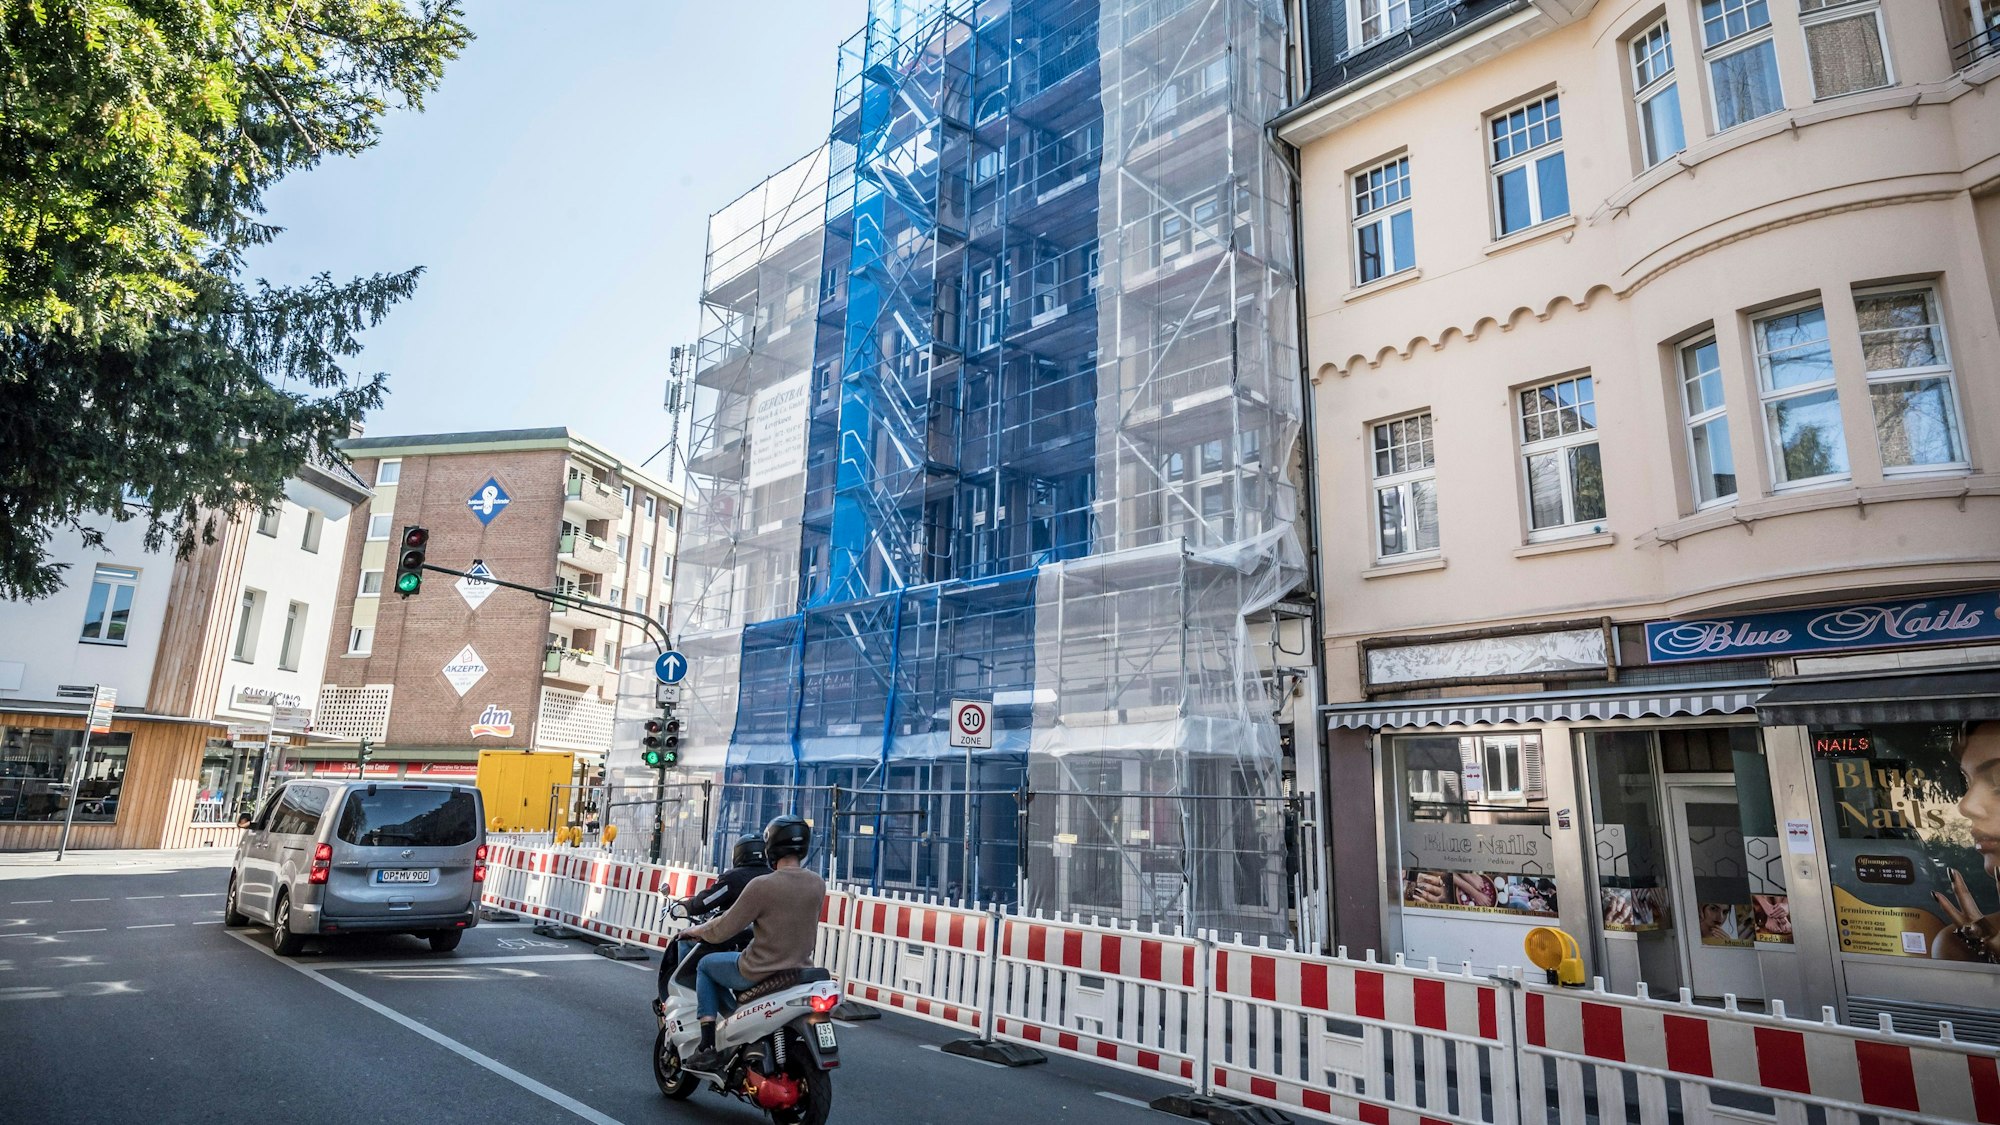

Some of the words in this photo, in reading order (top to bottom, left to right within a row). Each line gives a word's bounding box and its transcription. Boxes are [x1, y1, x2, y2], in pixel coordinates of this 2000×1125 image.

[1654, 620, 1792, 654] Blue
[1807, 602, 1984, 642] Nails
[445, 665, 485, 673] AKZEPTA
[480, 706, 510, 725] dm
[964, 712, 980, 727] 30
[960, 736, 982, 745] ZONE
[1817, 737, 1870, 752] NAILS
[375, 763, 390, 771] Center
[1832, 759, 1926, 789] Blue
[1837, 800, 1946, 829] Nails
[1423, 831, 1473, 853] Blue
[1476, 834, 1538, 856] Nails
[383, 871, 395, 880] OP
[399, 871, 411, 880] MV
[412, 871, 428, 880] 900
[1840, 906, 1920, 919] Terminvereinbarung
[736, 1001, 772, 1020] GILERA
